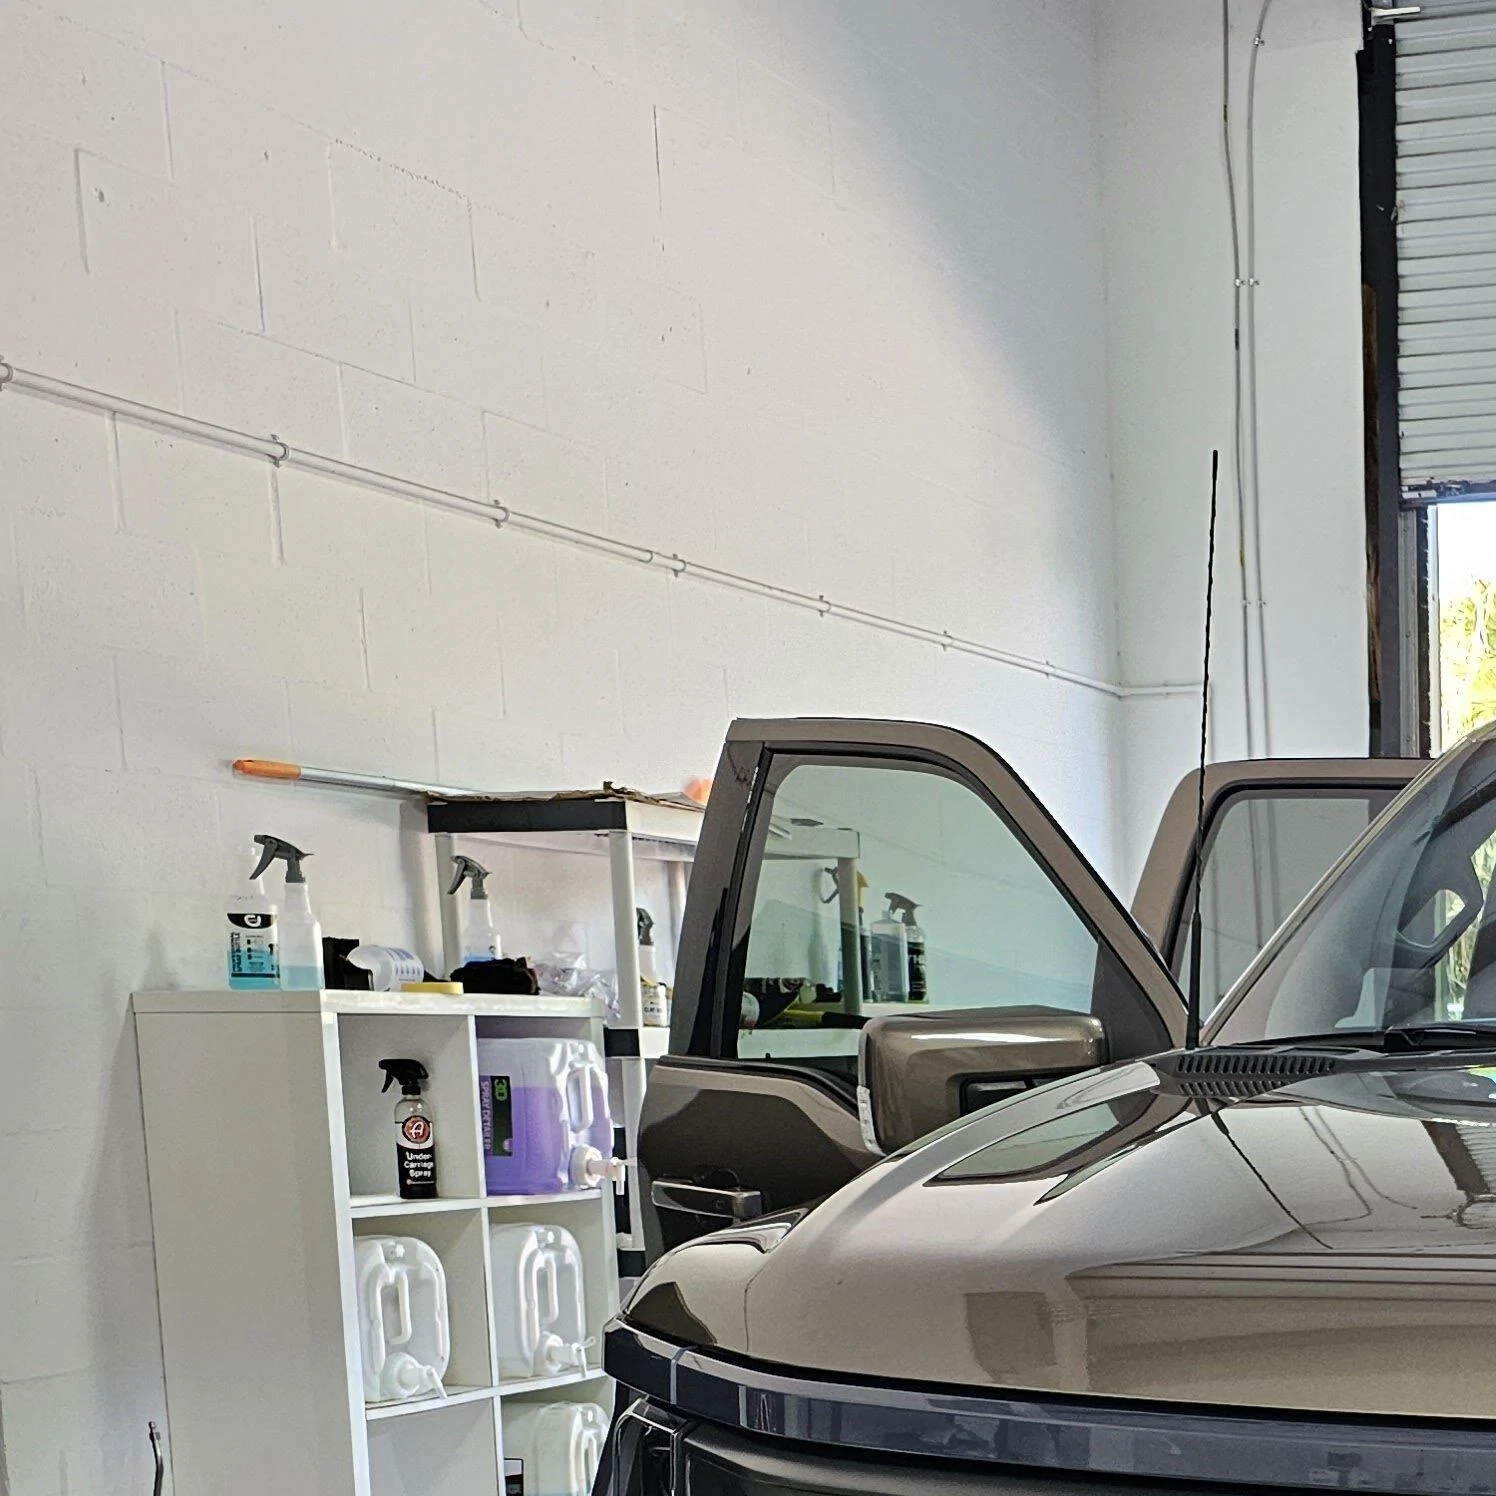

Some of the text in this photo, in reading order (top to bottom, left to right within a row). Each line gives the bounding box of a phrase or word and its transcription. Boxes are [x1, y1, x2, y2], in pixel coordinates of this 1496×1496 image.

[494, 1079, 508, 1101] 3D
[480, 1081, 492, 1150] SPRAY DETAILER
